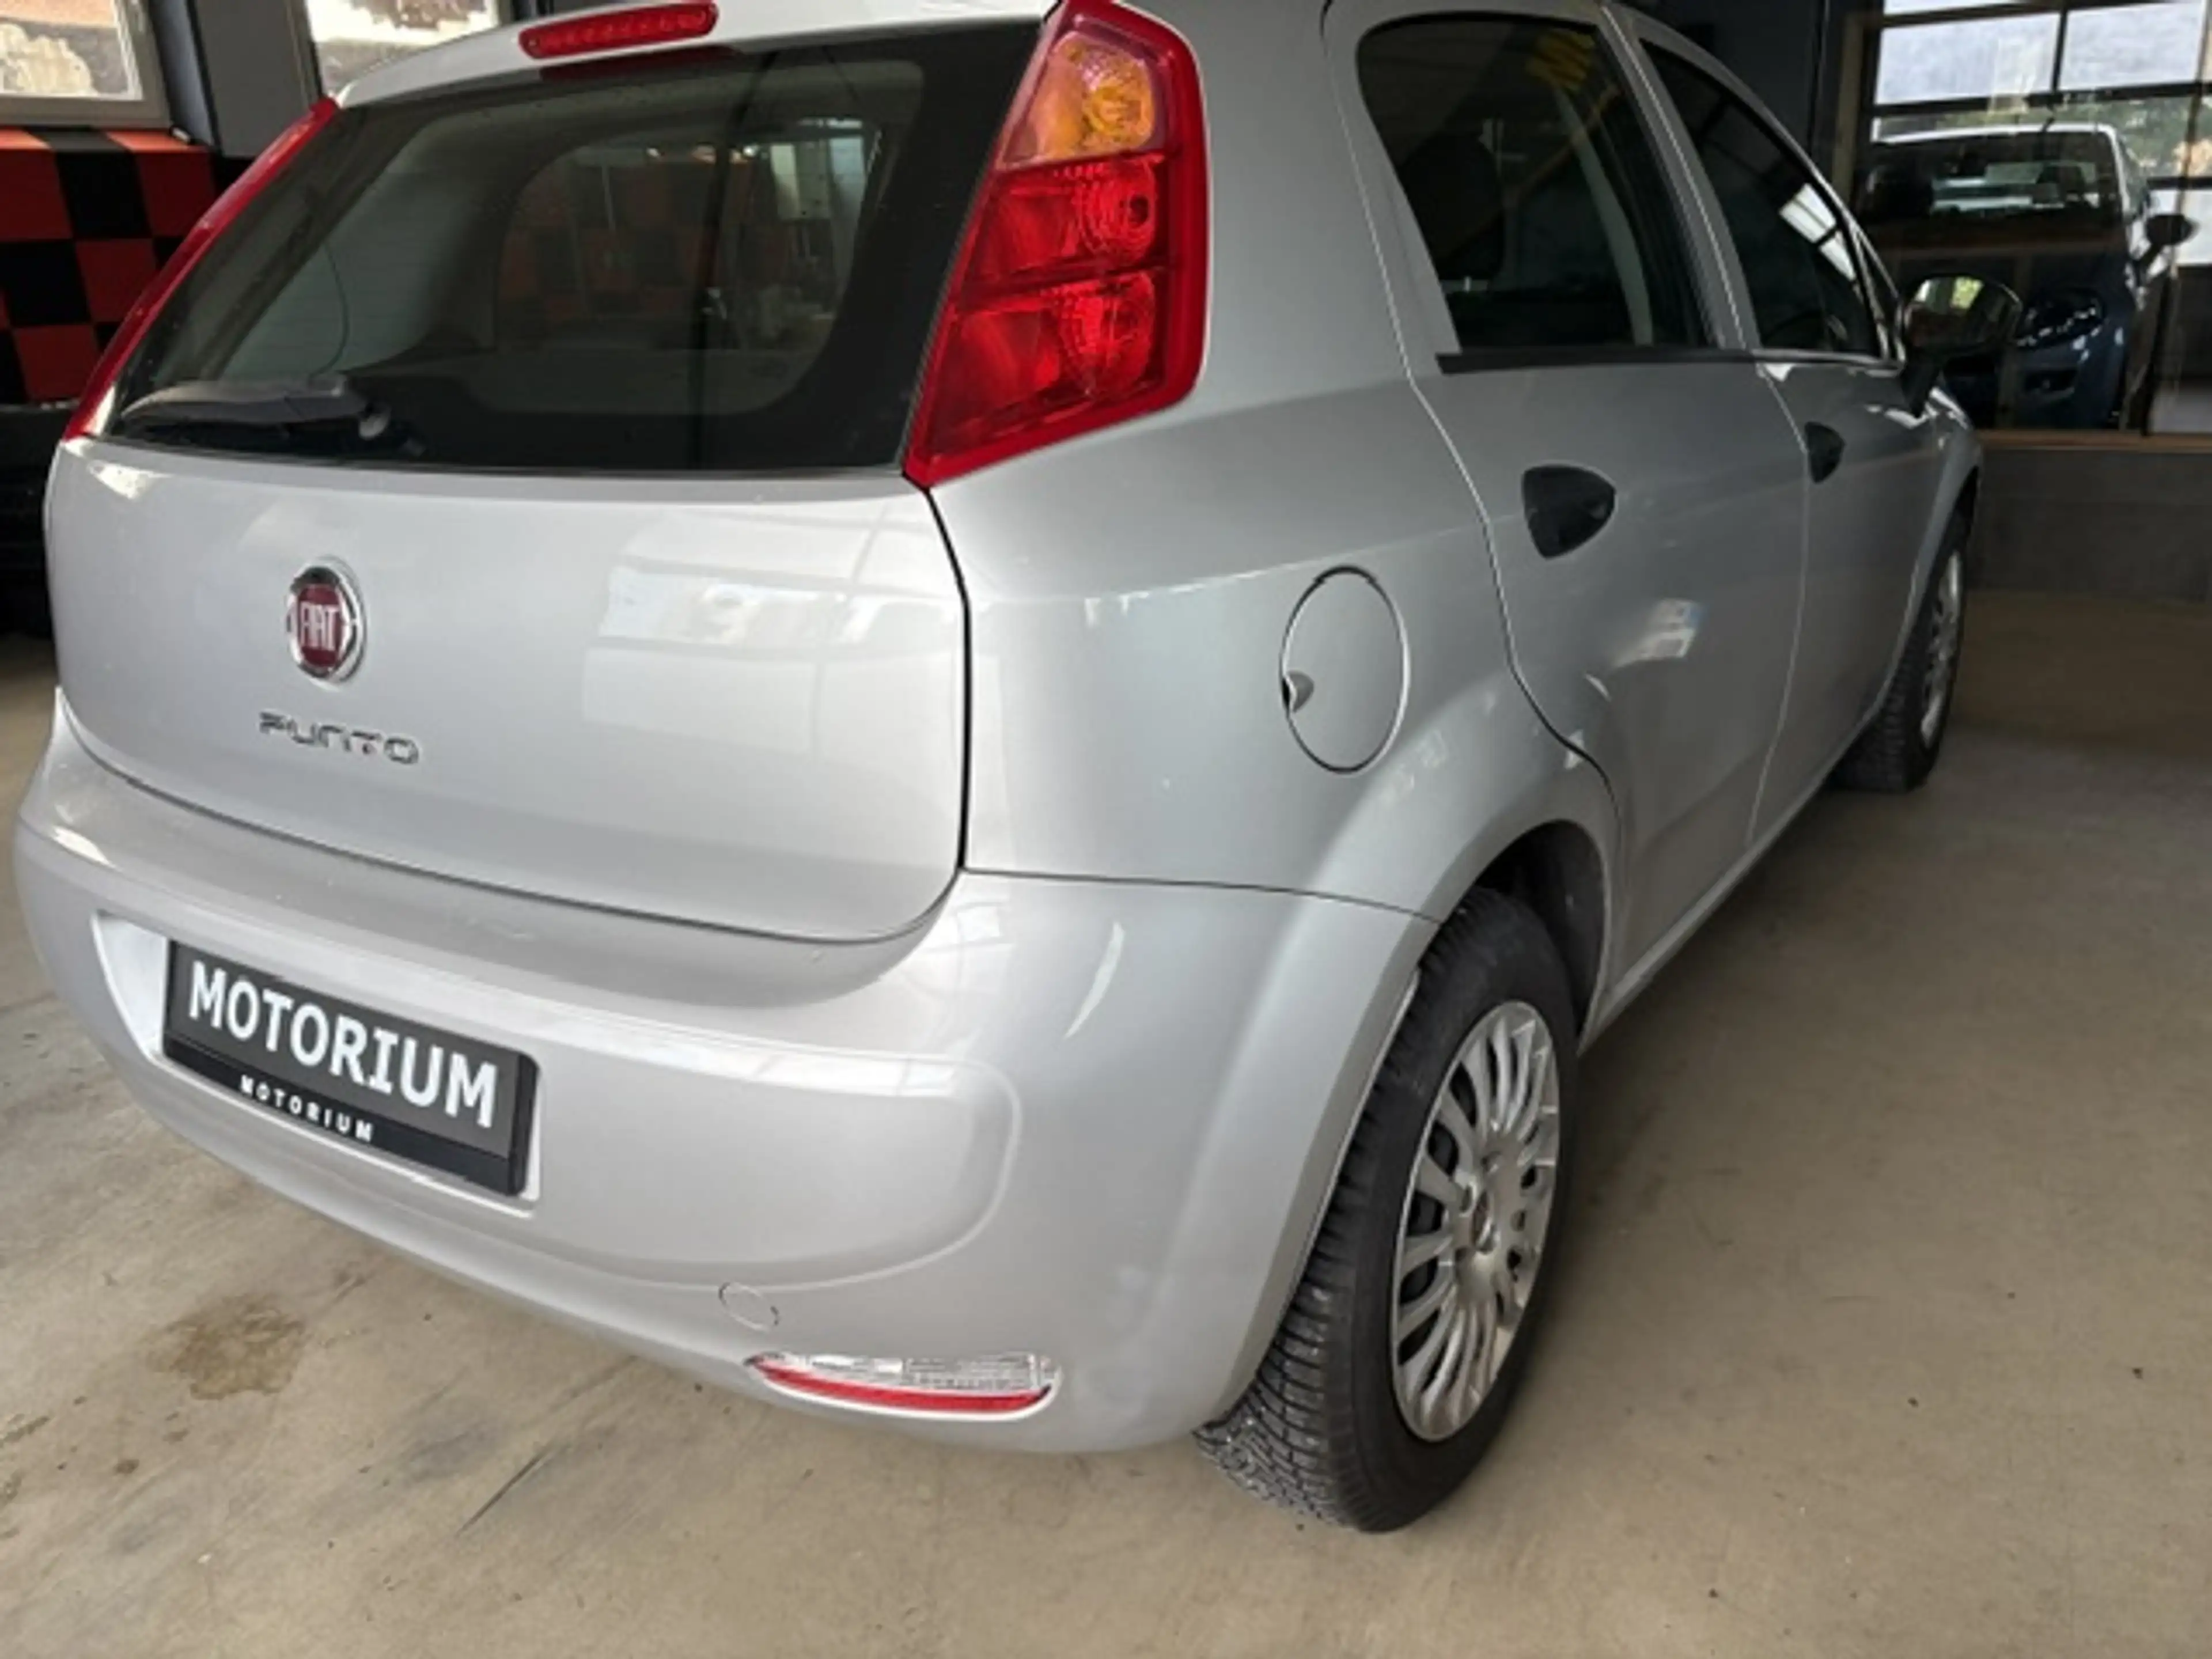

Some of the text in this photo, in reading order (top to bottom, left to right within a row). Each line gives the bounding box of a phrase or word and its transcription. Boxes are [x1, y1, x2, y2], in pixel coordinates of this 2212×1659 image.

[300, 601, 340, 651] FIAT
[259, 710, 419, 764] PUNTO
[189, 960, 497, 1128] MOTORIUM
[240, 1075, 374, 1142] MOTORIUM
